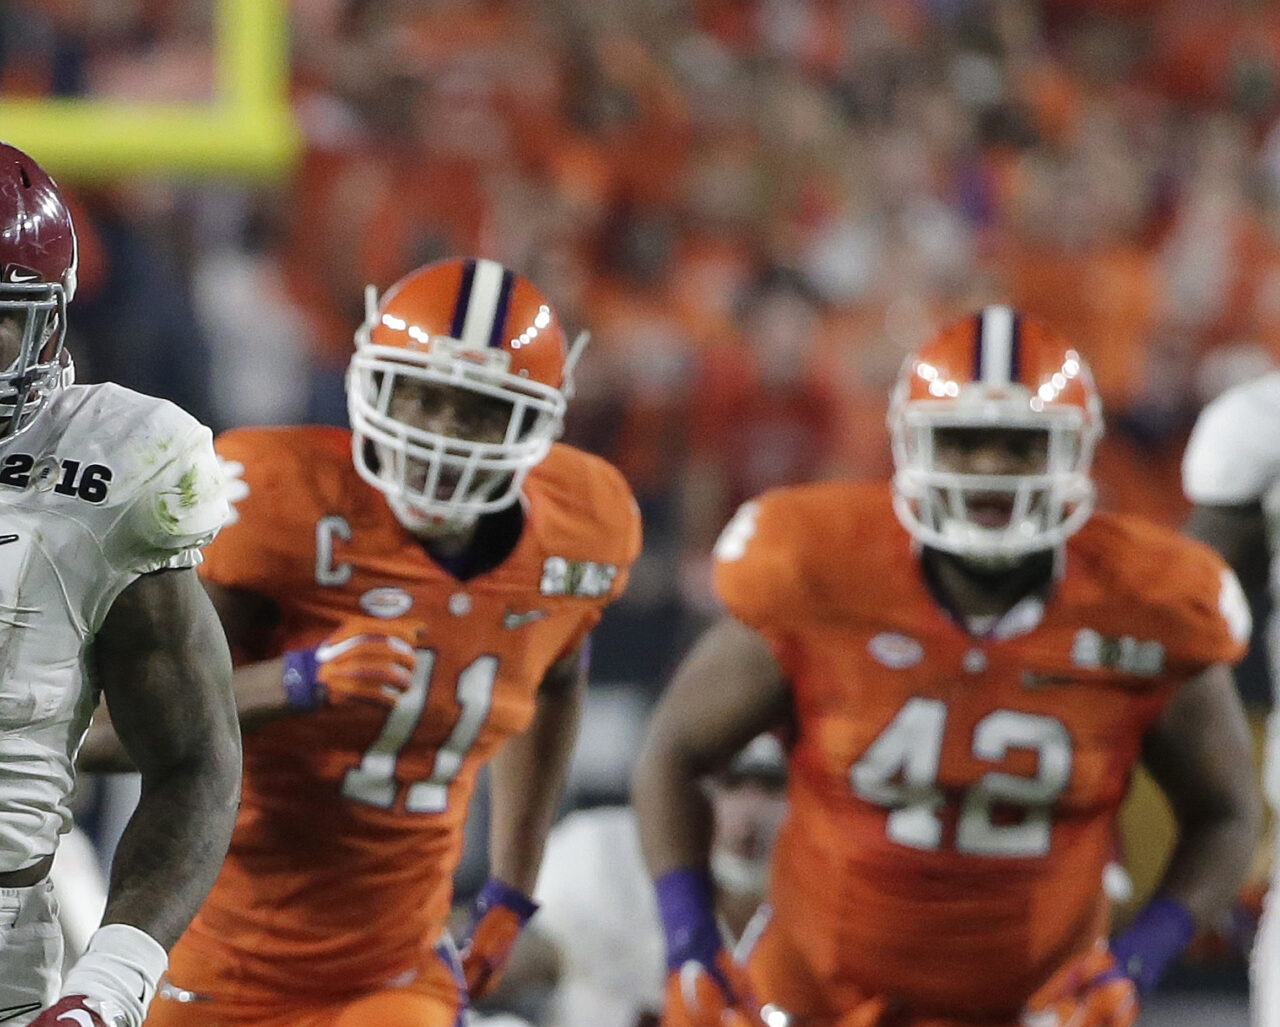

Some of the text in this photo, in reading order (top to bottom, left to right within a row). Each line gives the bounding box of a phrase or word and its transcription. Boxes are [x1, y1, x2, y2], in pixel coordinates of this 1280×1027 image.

[315, 514, 353, 587] C
[341, 648, 500, 813] 11
[850, 696, 1074, 858] 42
